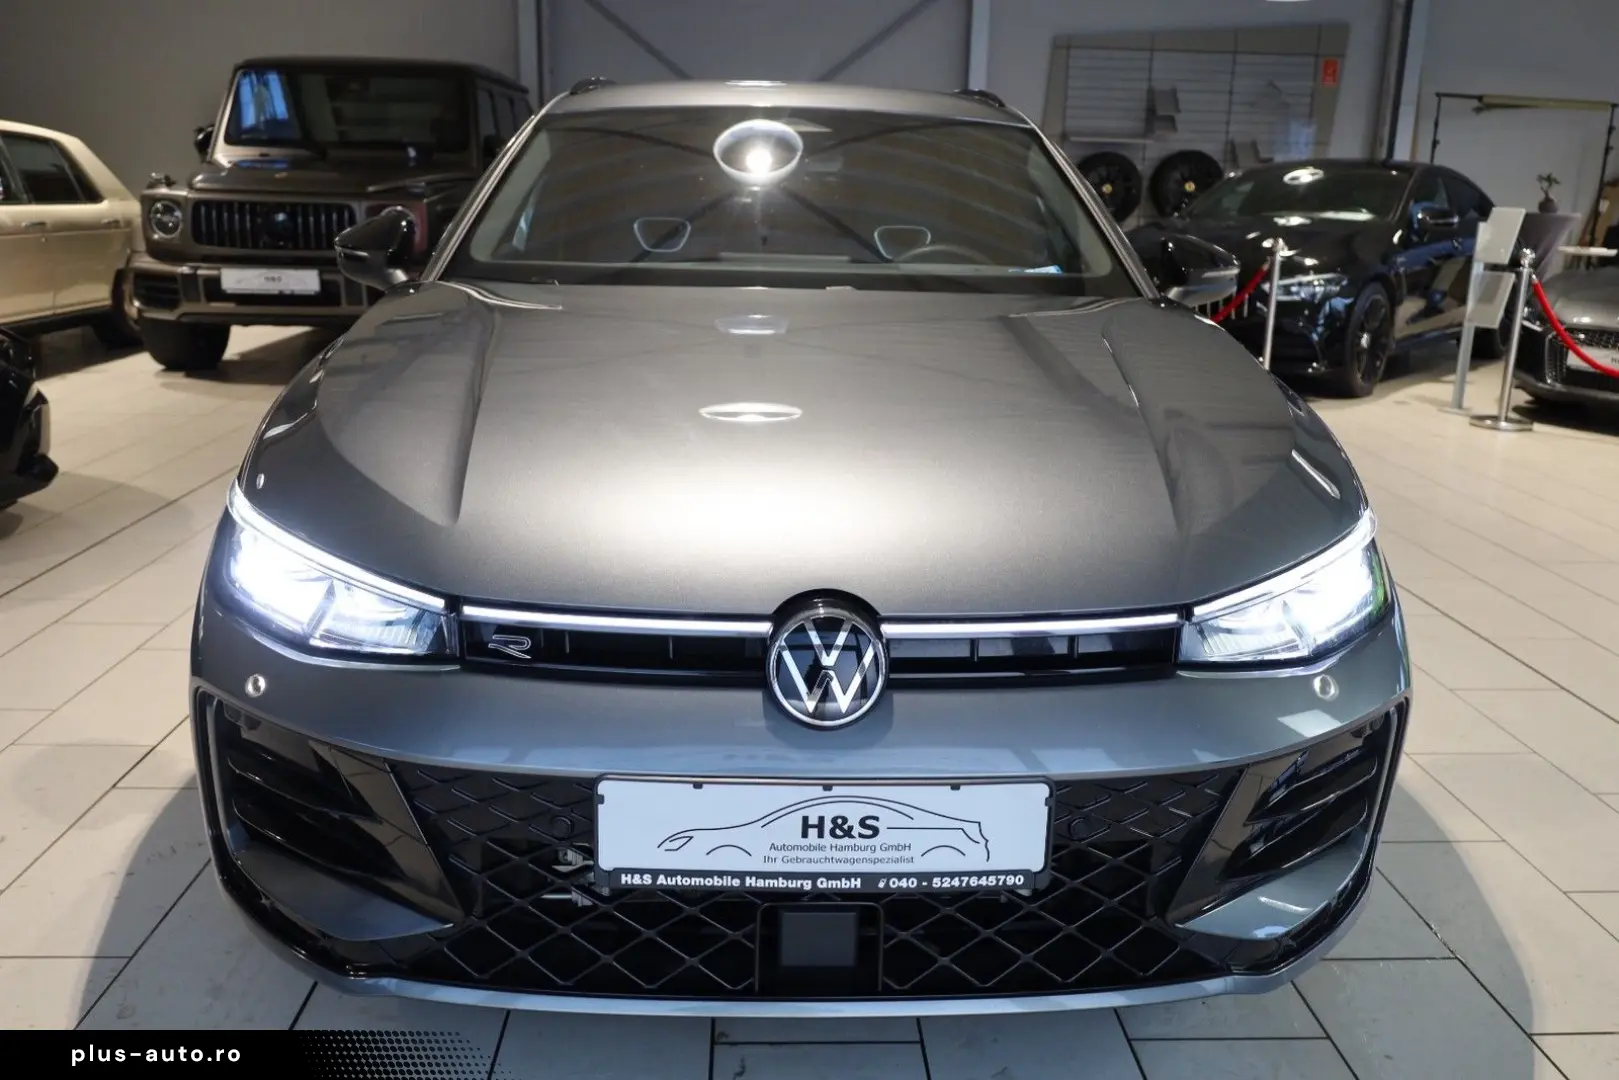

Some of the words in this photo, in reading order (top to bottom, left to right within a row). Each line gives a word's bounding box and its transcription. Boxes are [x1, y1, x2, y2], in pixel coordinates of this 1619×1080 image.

[800, 815, 880, 840] H&S
[768, 842, 827, 852] Automobile
[829, 843, 877, 854] Hamburg
[879, 842, 912, 852] GmbH
[763, 855, 777, 864] Ihr
[781, 854, 914, 866] Gebrauchtwagenspezialist
[620, 873, 653, 885] H&S
[656, 874, 741, 887] Automobile
[744, 876, 812, 890] Hamburg
[816, 877, 861, 889] GmbH
[888, 877, 918, 889] 040
[931, 874, 1025, 889] 5247645790
